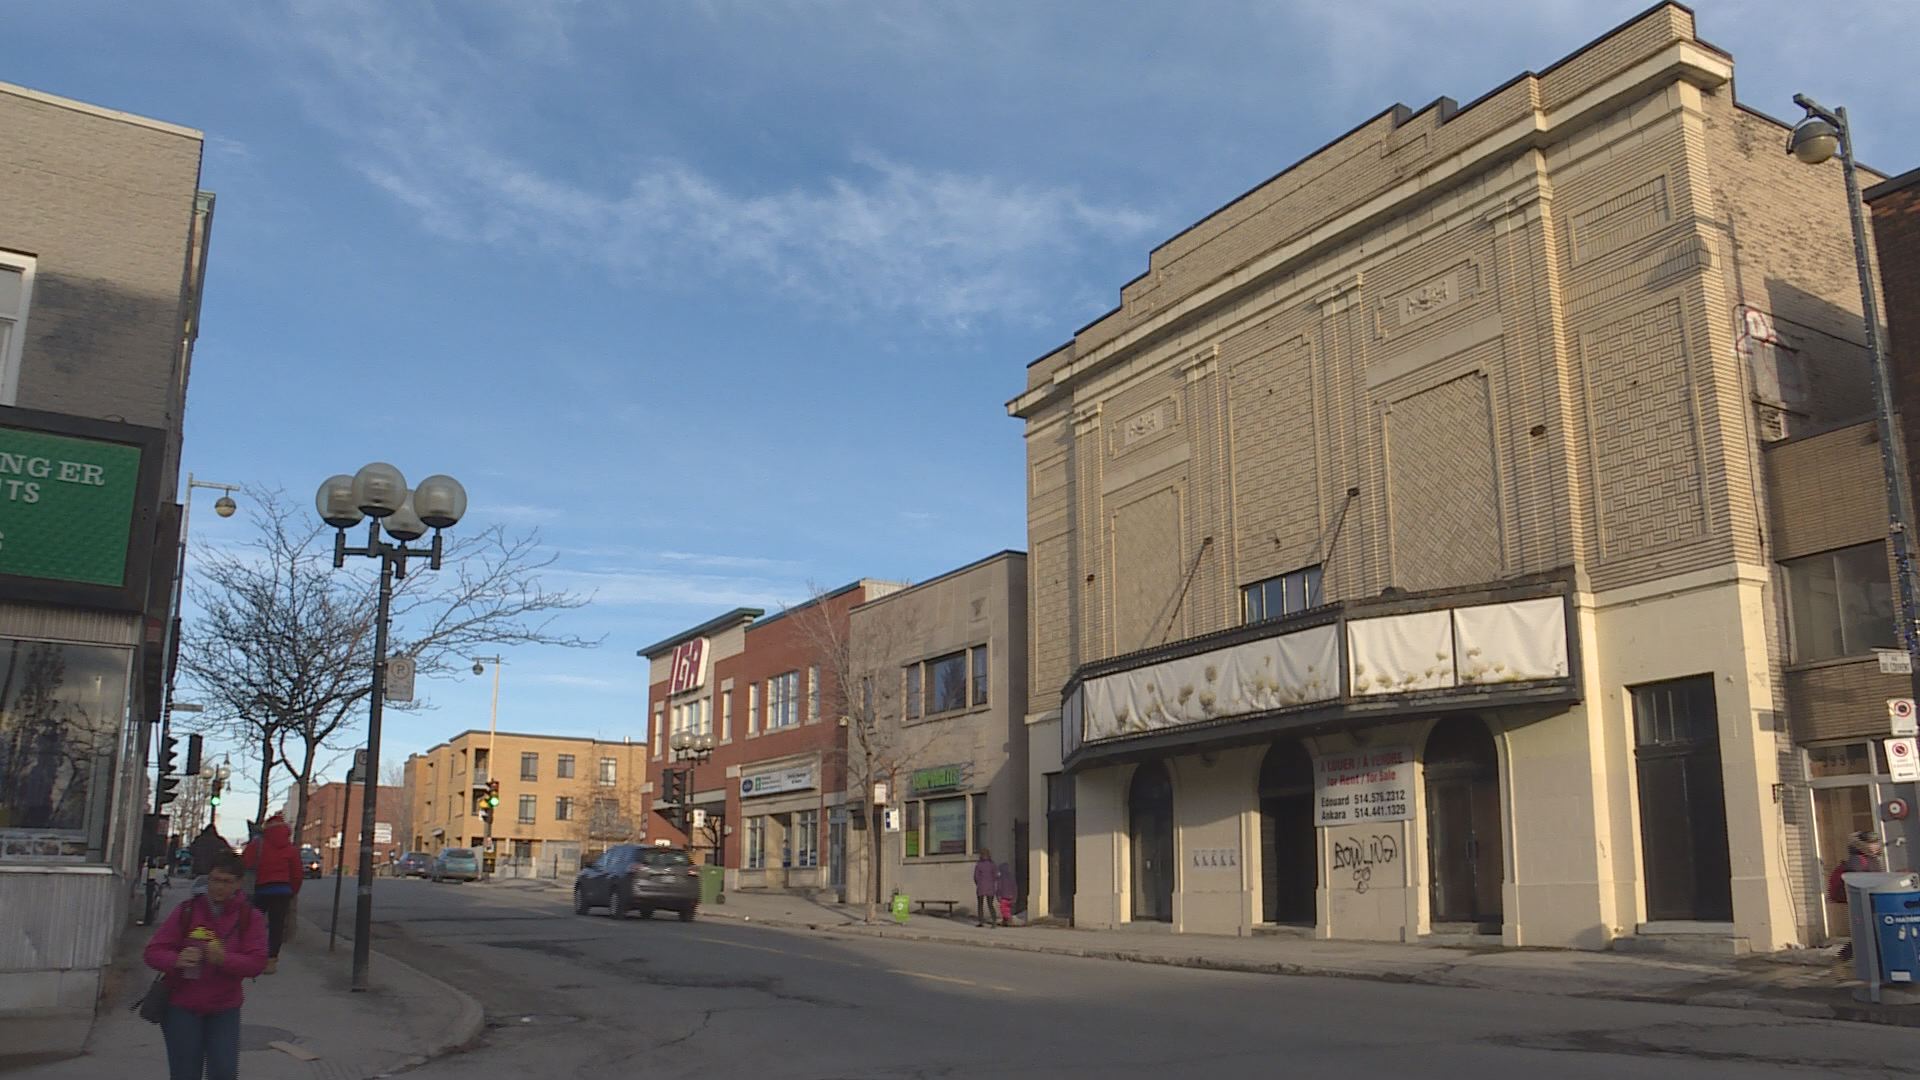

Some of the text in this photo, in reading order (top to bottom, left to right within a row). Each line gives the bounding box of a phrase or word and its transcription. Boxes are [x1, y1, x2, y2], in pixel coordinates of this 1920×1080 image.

[0, 478, 40, 504] TS
[668, 638, 704, 695] IGA
[1327, 758, 1355, 772] LOUER
[1339, 774, 1359, 786] Rent
[1321, 794, 1350, 807] Edouard
